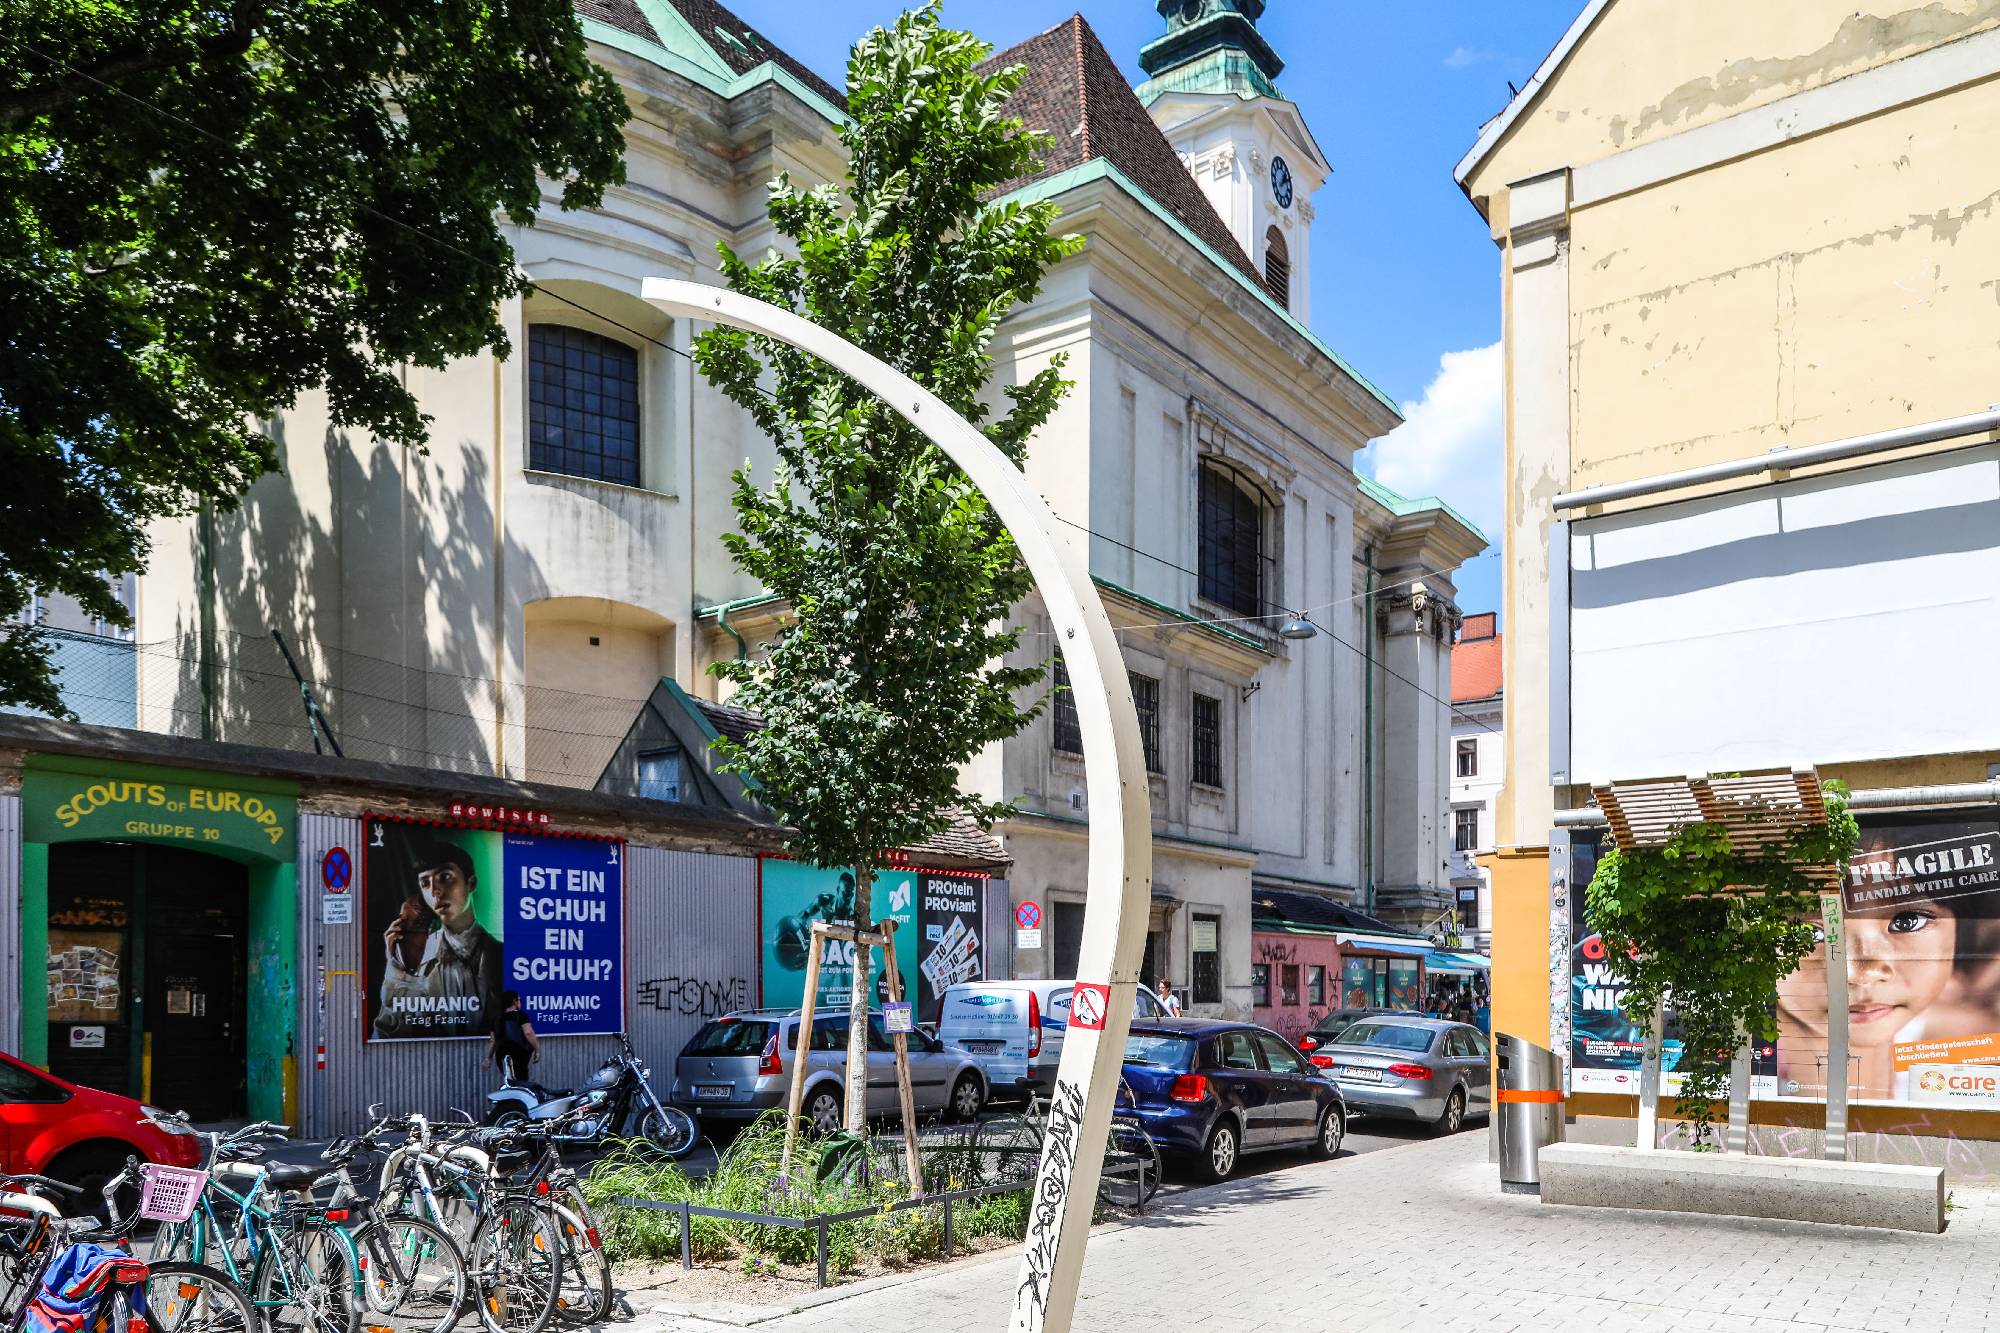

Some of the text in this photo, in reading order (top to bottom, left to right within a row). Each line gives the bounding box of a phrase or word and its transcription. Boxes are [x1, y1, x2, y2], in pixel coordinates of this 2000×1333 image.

[55, 781, 285, 844] SCOUTS OF EUROPA
[453, 804, 548, 823] gewista
[125, 821, 220, 840] GRUPPE 10
[1849, 843, 1994, 886] FRAGILE
[521, 866, 605, 893] IST EIN
[928, 879, 974, 896] PROtein
[1854, 870, 1999, 903] HANDLE WITH CARE
[519, 897, 606, 922] SCHUH
[925, 897, 977, 913] PROviant
[545, 928, 584, 951] EIN
[935, 943, 946, 961] 10
[949, 952, 959, 970] 10
[512, 957, 613, 981] SCHUH?
[948, 971, 958, 985] 10
[393, 996, 480, 1012] HUMANIC
[526, 995, 601, 1011] HUMANIC
[405, 1014, 469, 1027] Frag Franz.
[537, 1012, 592, 1024] Frag Franz.
[1894, 1037, 1993, 1055] Jetzt Kinderpatenschaft
[1949, 1076, 1996, 1091] care
